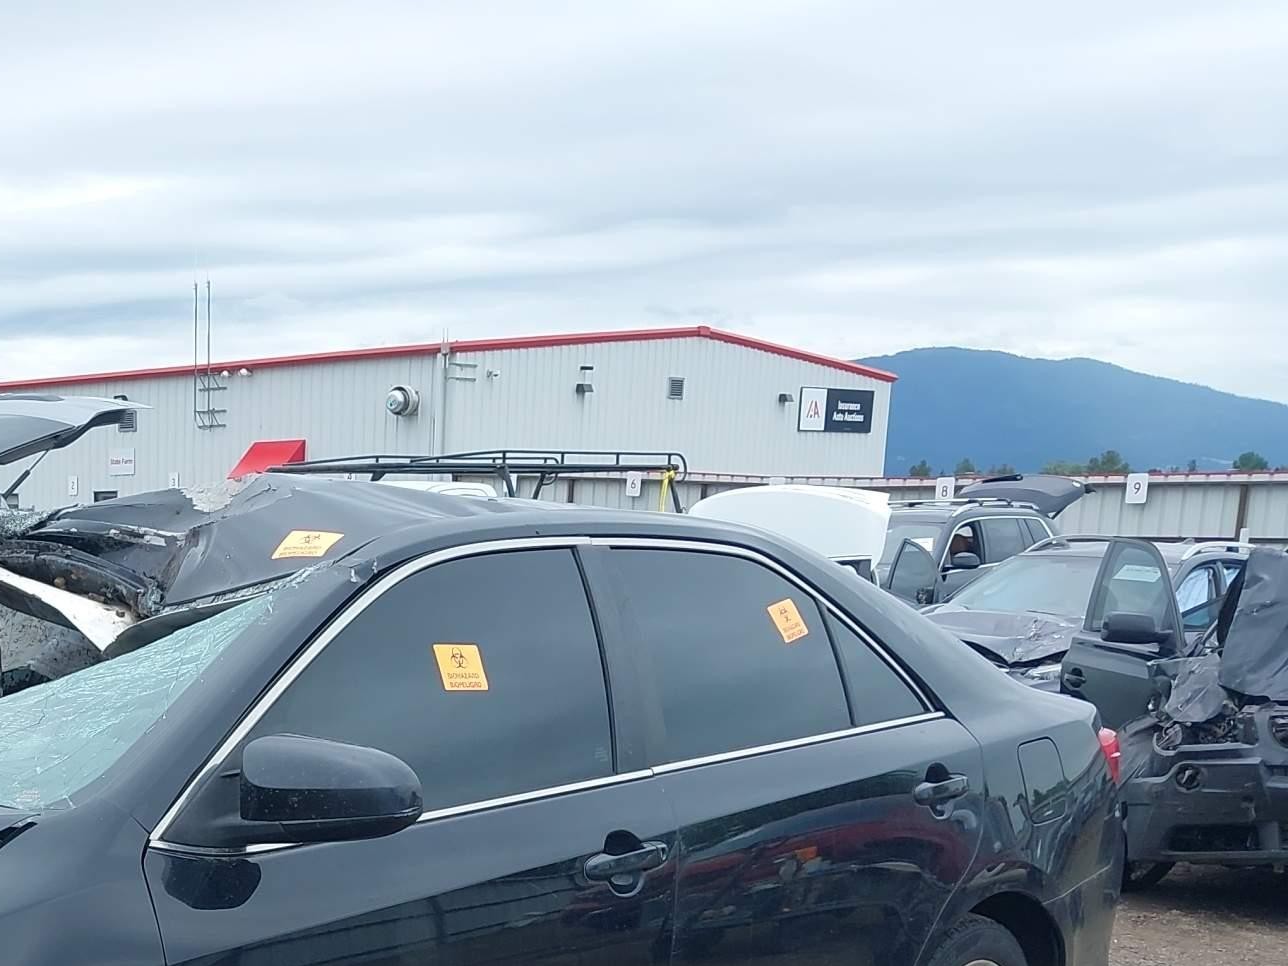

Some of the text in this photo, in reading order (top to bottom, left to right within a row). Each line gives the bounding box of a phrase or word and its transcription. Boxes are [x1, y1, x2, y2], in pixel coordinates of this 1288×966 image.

[630, 478, 636, 489] 6
[1133, 481, 1142, 495] 9
[941, 485, 948, 497] 8
